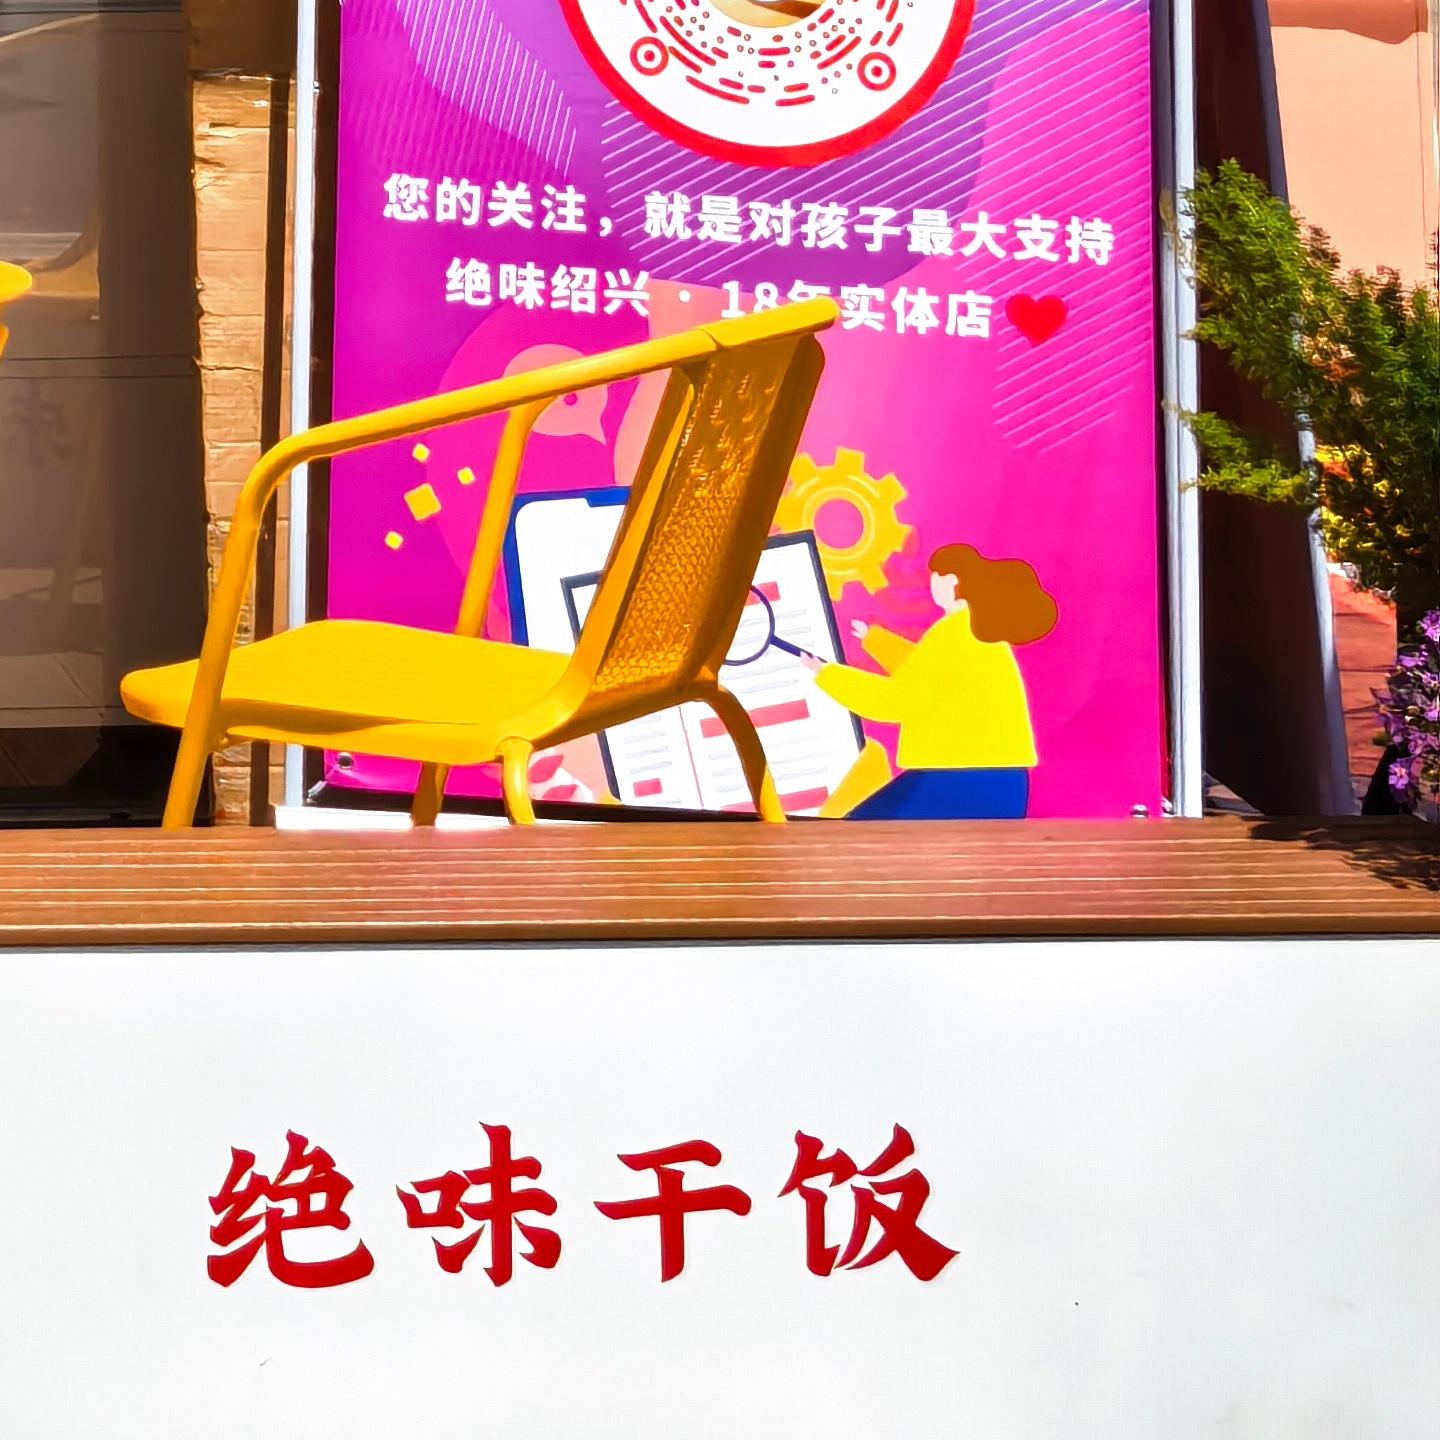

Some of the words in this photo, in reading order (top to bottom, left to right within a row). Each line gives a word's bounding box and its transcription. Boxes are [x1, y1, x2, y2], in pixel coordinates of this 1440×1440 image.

[382, 172, 1114, 267] 您的关注，就是对孩子最大支持
[207, 1121, 961, 1288] 绝味干饭
